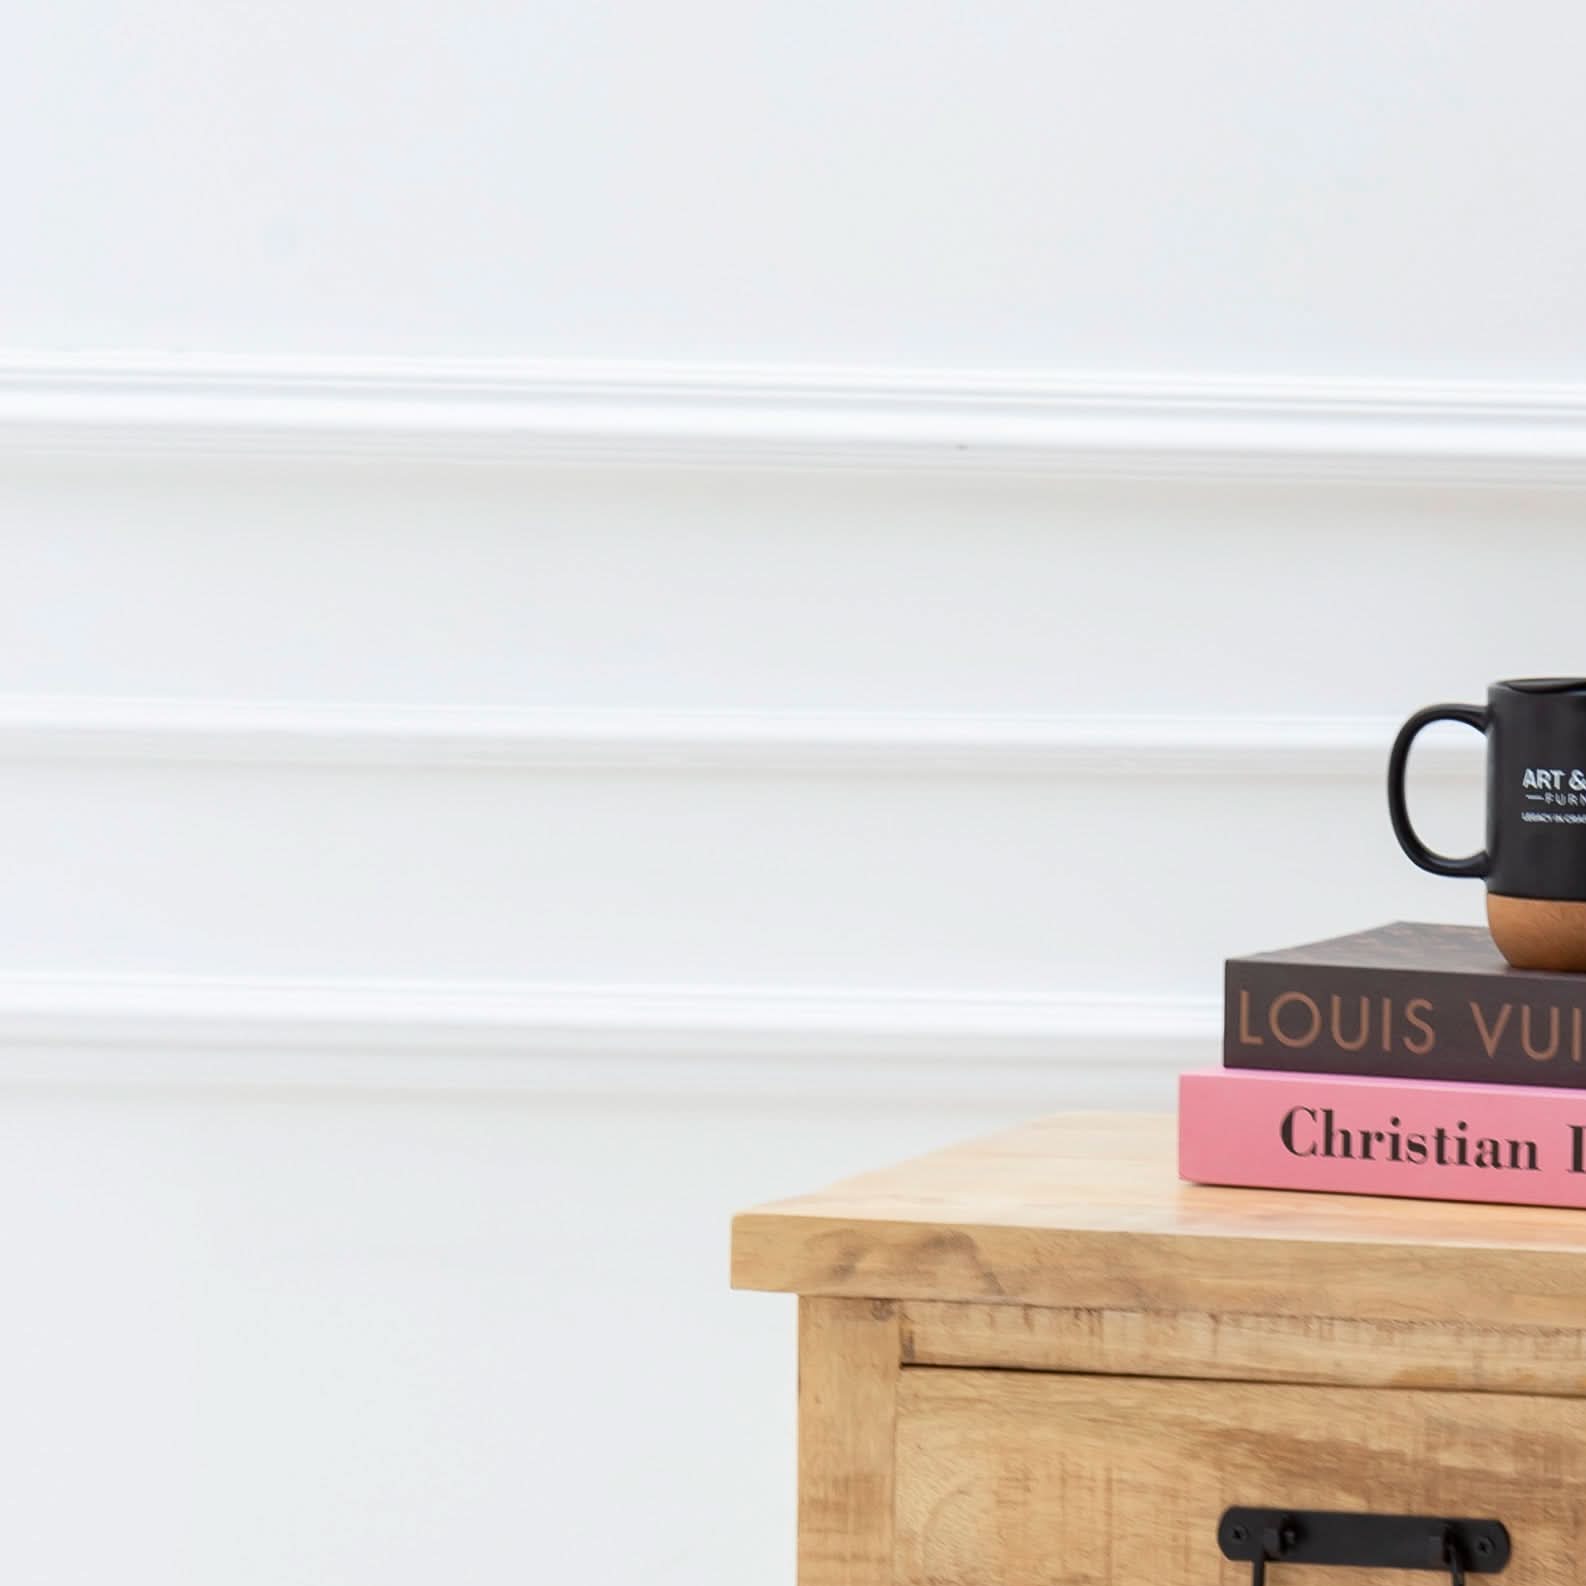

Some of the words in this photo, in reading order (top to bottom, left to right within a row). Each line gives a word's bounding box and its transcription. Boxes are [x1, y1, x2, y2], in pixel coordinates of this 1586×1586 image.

[1521, 768, 1567, 791] ART
[1238, 990, 1439, 1057] LOUIS
[1280, 1106, 1541, 1172] Christian
